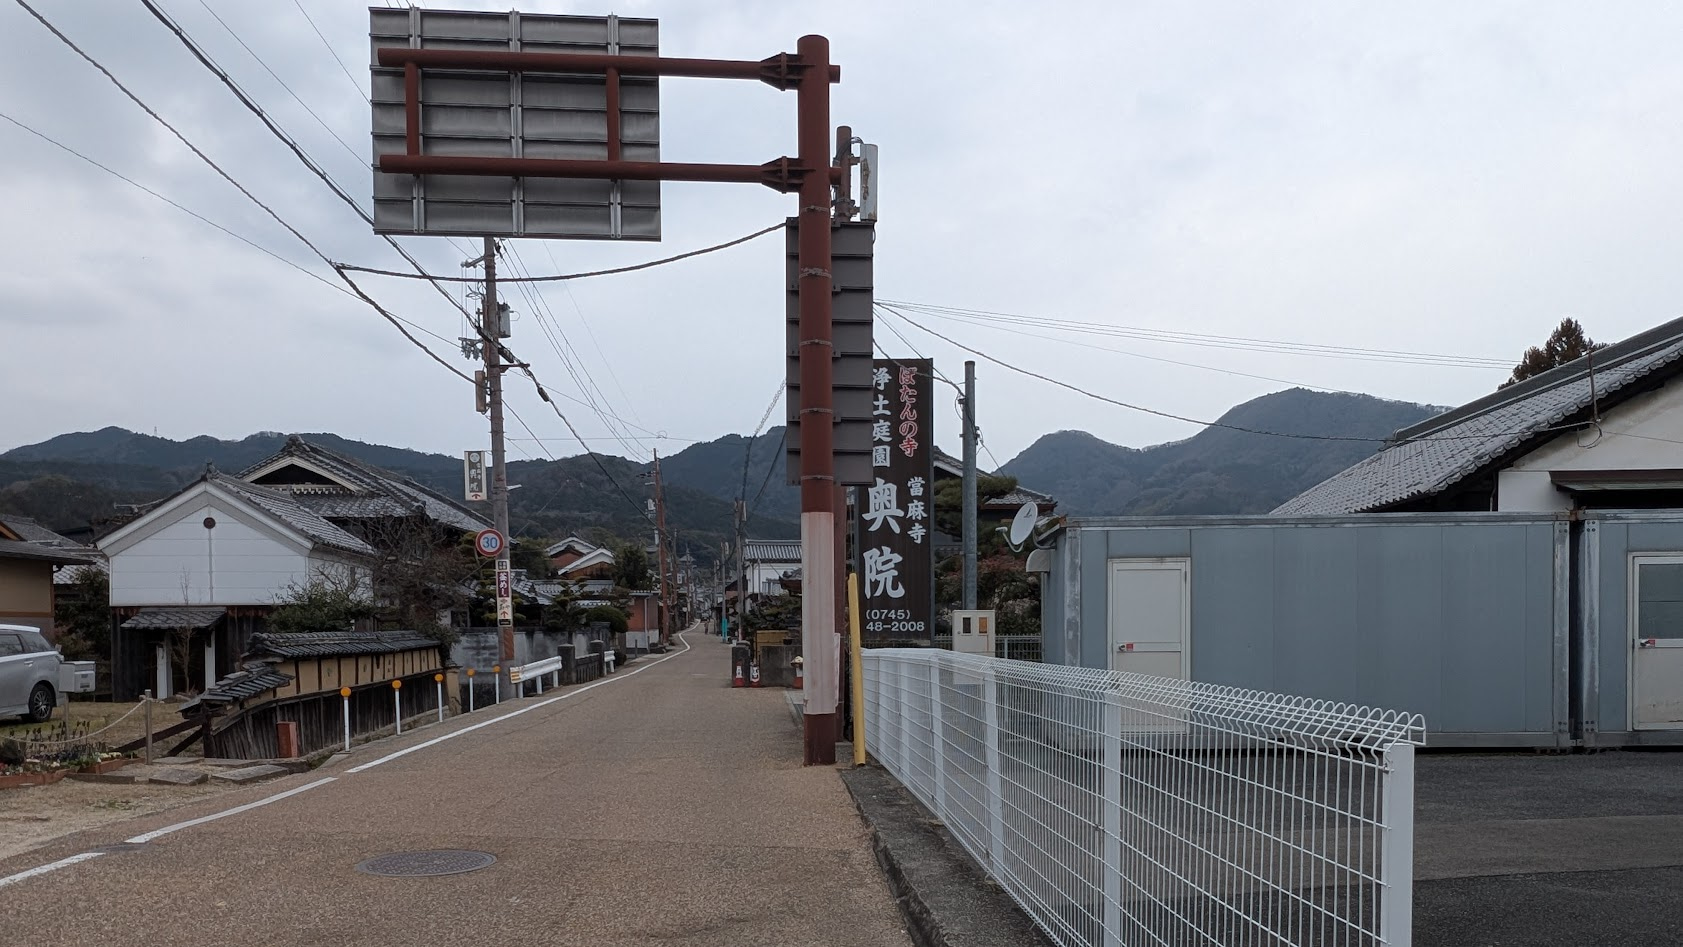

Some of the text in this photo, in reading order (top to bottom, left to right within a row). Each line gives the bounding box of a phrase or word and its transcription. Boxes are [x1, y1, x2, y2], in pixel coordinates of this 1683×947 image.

[872, 367, 892, 467] 浄土庭園
[906, 476, 928, 544] 當麻寺
[482, 536, 498, 549] 30
[861, 477, 905, 599] 奥院
[865, 609, 911, 619] (0745)
[866, 621, 925, 632] 48-2008
